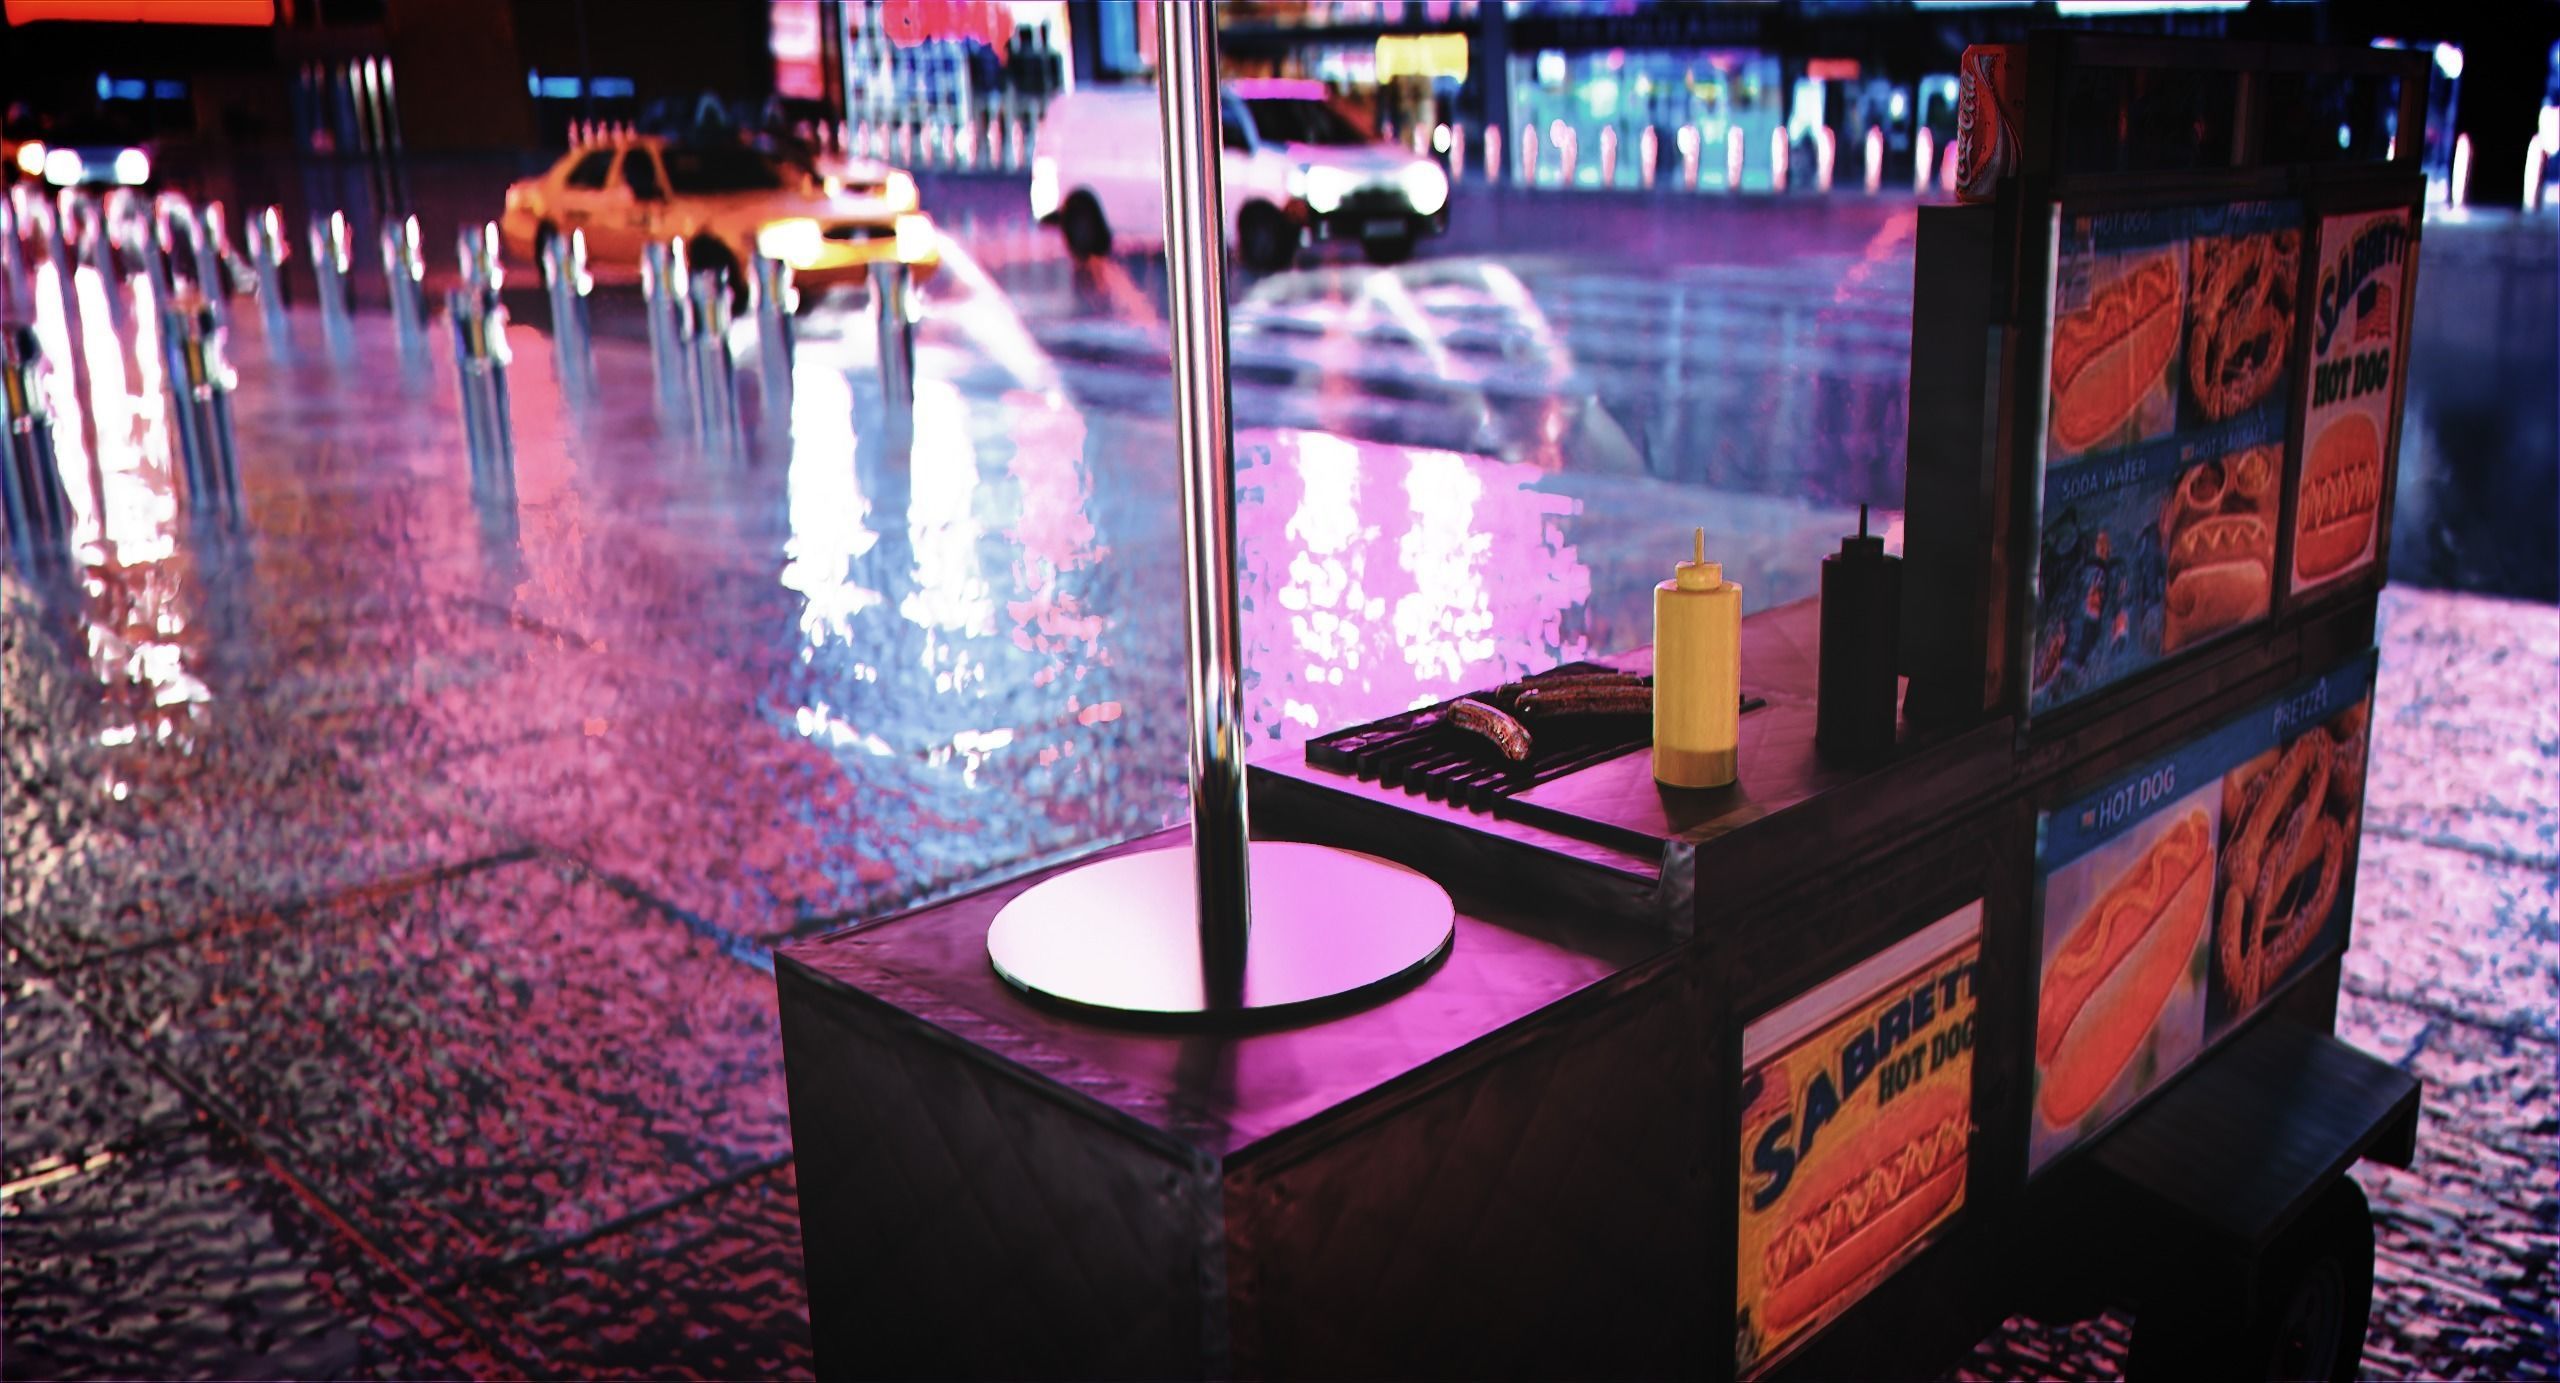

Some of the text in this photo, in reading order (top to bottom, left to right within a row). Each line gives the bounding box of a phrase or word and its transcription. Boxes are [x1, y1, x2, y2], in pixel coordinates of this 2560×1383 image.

[2316, 220, 2405, 356] SABRETT
[2313, 348, 2389, 408] HOT DOG
[2063, 457, 2146, 498] SODA WATER
[2099, 763, 2175, 831] HOT DOG
[1752, 961, 1978, 1210] SABRETT
[1878, 1013, 1976, 1107] HOT DOG
